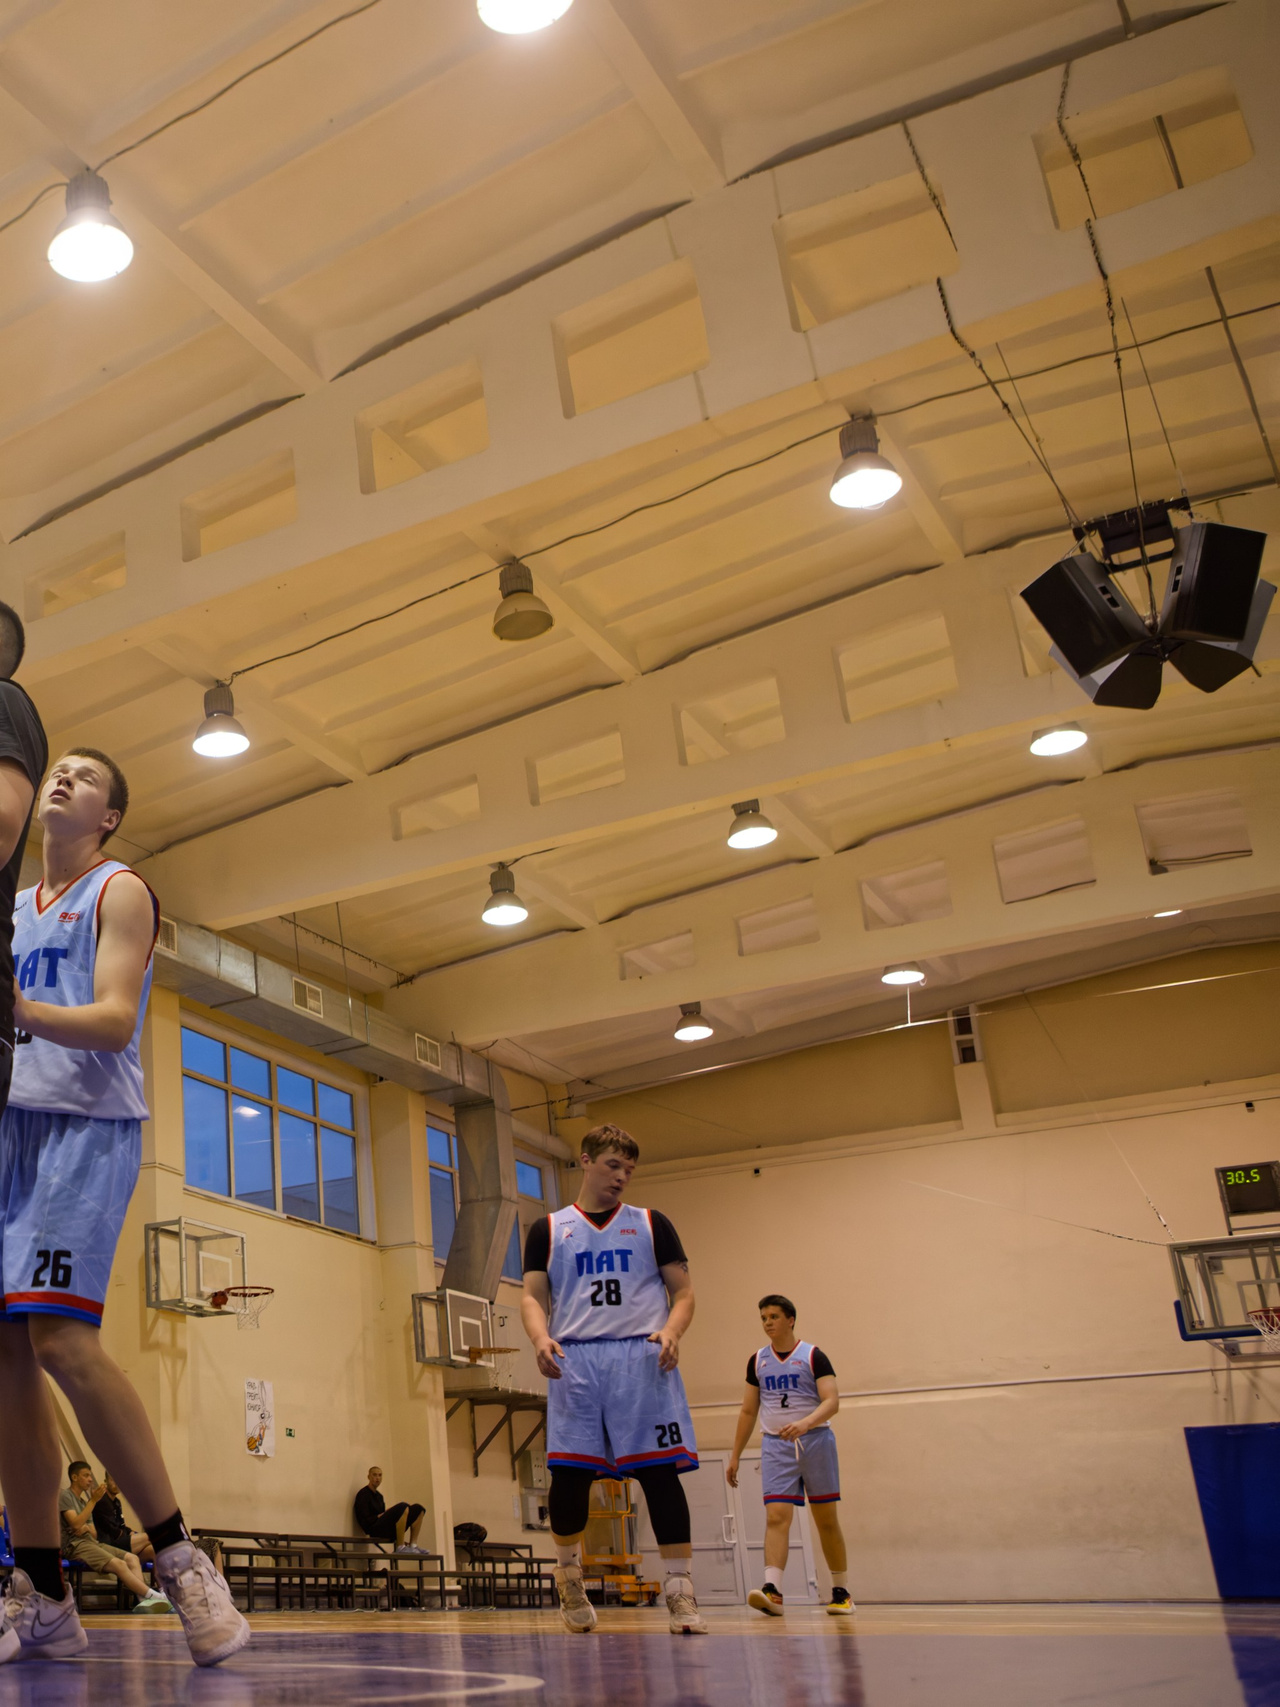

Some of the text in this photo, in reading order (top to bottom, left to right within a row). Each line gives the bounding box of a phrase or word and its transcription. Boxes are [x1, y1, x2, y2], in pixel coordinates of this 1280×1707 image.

[1226, 1168, 1261, 1185] 30.5
[31, 1250, 72, 1289] 26
[590, 1279, 622, 1307] 28
[765, 1374, 800, 1390] ПАТ
[780, 1393, 789, 1408] 2
[655, 1422, 683, 1448] 28
